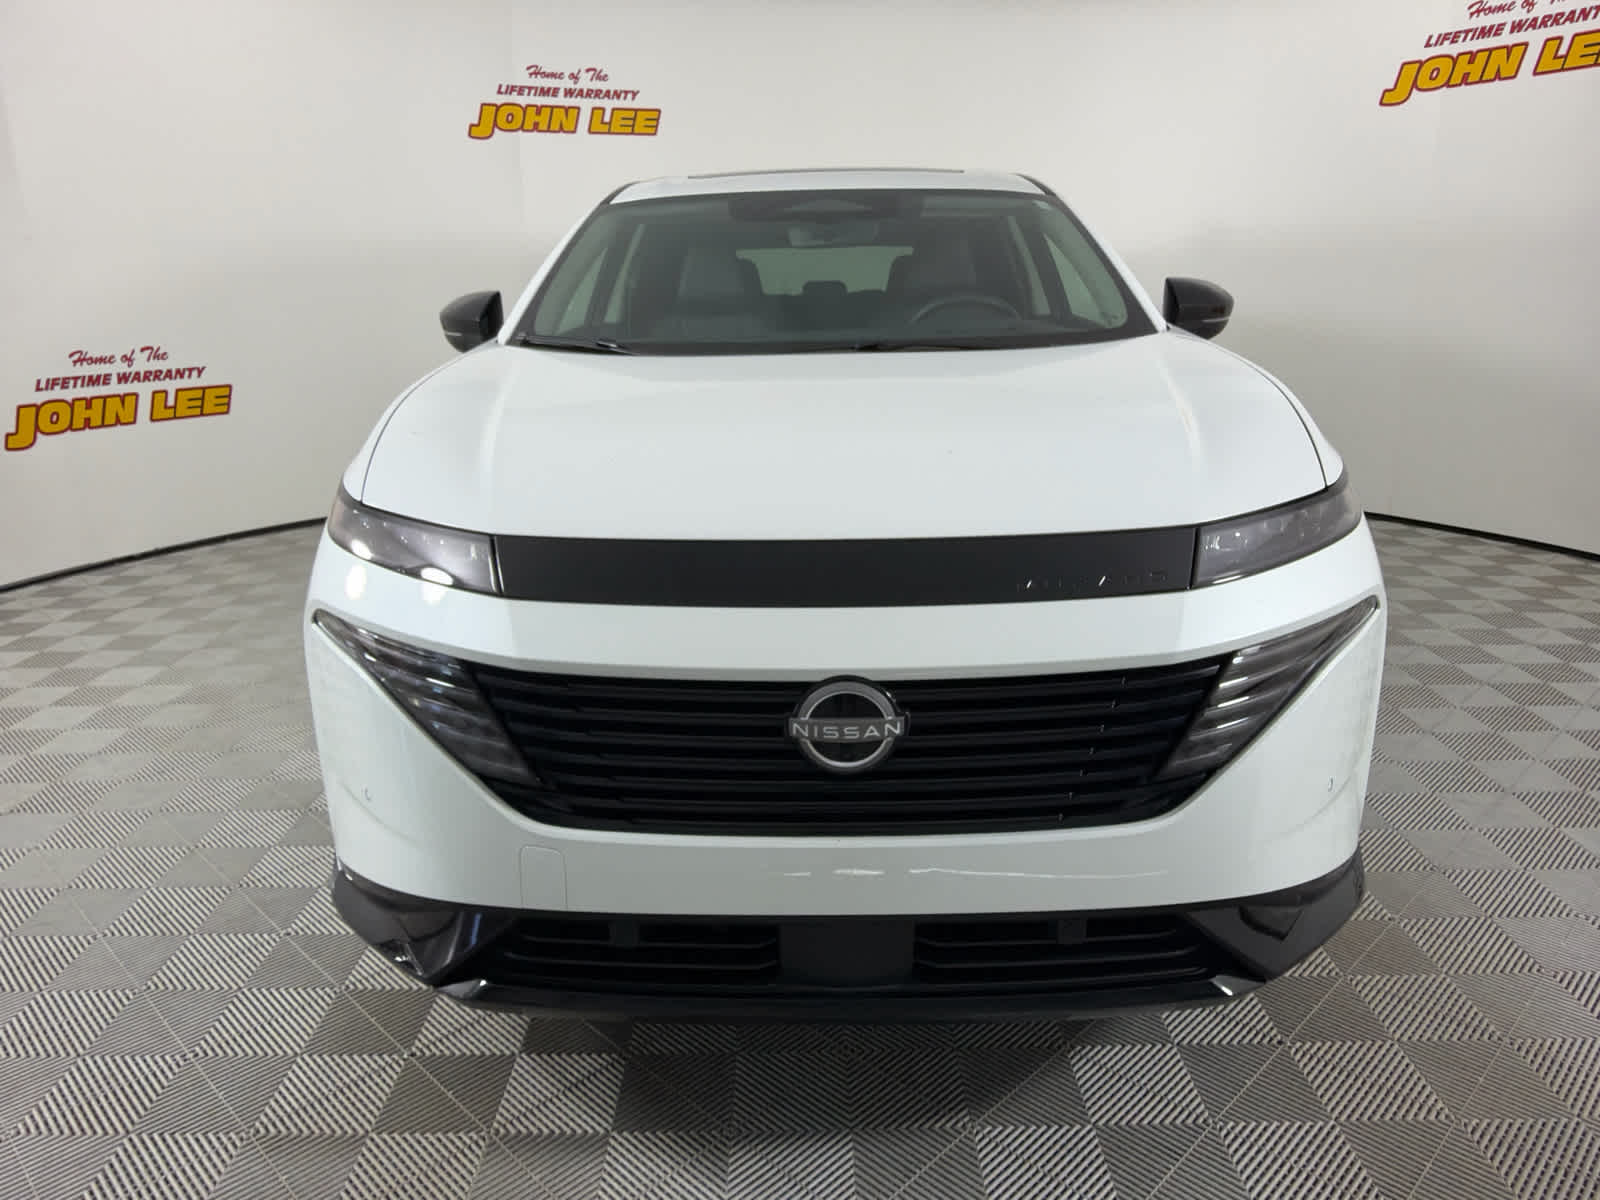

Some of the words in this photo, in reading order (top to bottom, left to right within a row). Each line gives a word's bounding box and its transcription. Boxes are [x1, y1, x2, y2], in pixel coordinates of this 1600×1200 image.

[1467, 0, 1516, 20] Home
[1424, 22, 1507, 48] LIFETIME
[525, 64, 565, 80] Home
[568, 68, 582, 84] of
[585, 67, 609, 82] The
[1379, 42, 1529, 106] JOHN
[1532, 29, 1600, 76] LE
[496, 83, 560, 98] LIFETIME
[563, 87, 640, 101] WARRANTY
[468, 103, 580, 139] JOHN
[588, 107, 661, 135] LEE
[68, 349, 116, 367] Home
[120, 349, 135, 367] of
[140, 346, 168, 362] The
[35, 373, 112, 392] LIFETIME
[116, 366, 206, 385] WARRANTY
[5, 392, 139, 451] JOHN
[150, 384, 232, 422] LEE
[792, 721, 901, 739] NISSAN
